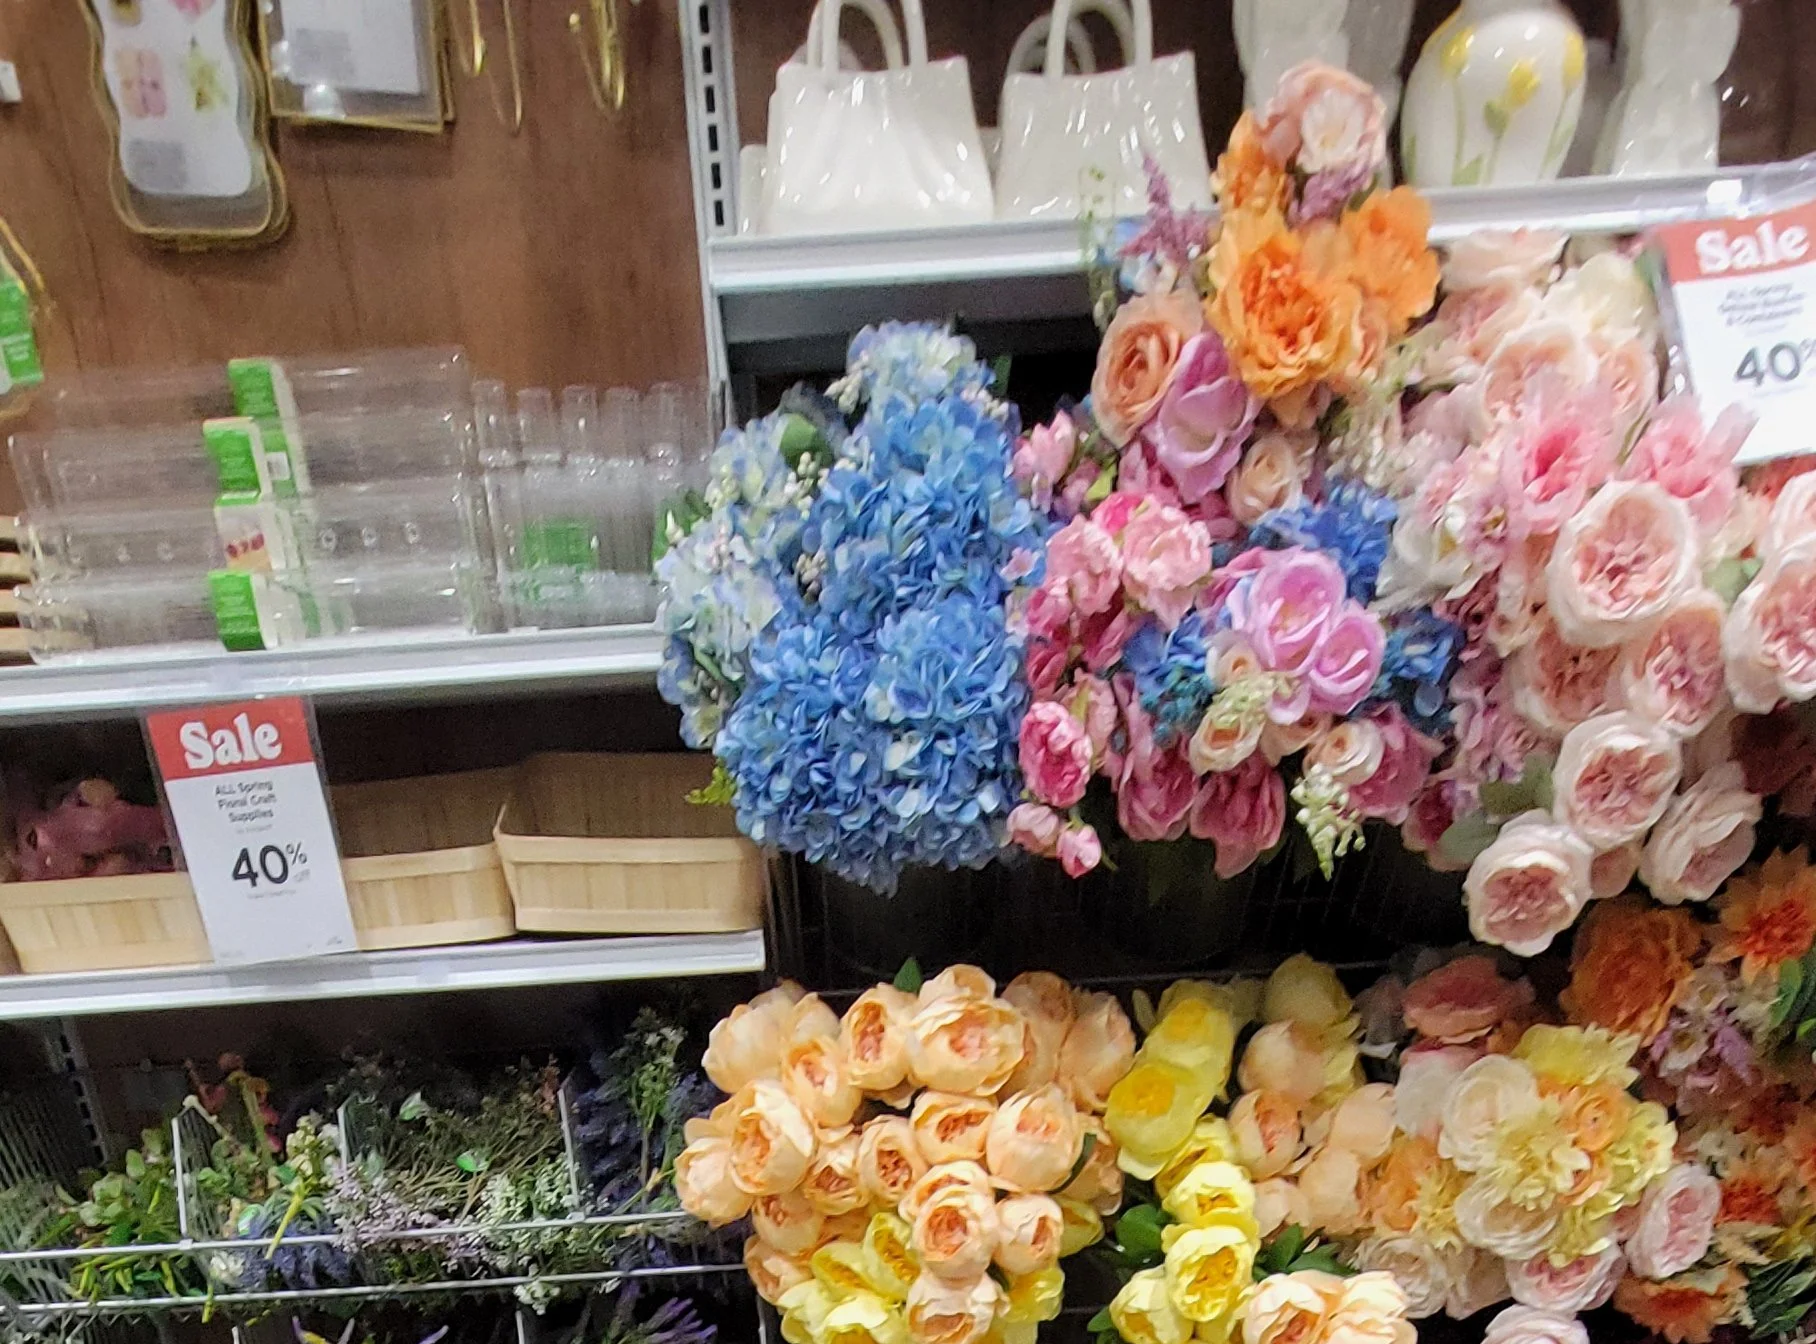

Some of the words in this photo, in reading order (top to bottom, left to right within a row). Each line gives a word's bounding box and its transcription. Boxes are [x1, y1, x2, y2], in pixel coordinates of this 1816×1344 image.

[1695, 220, 1811, 276] Sale
[179, 712, 283, 770] Sale
[237, 781, 273, 793] Spring
[228, 809, 274, 822] Supplies
